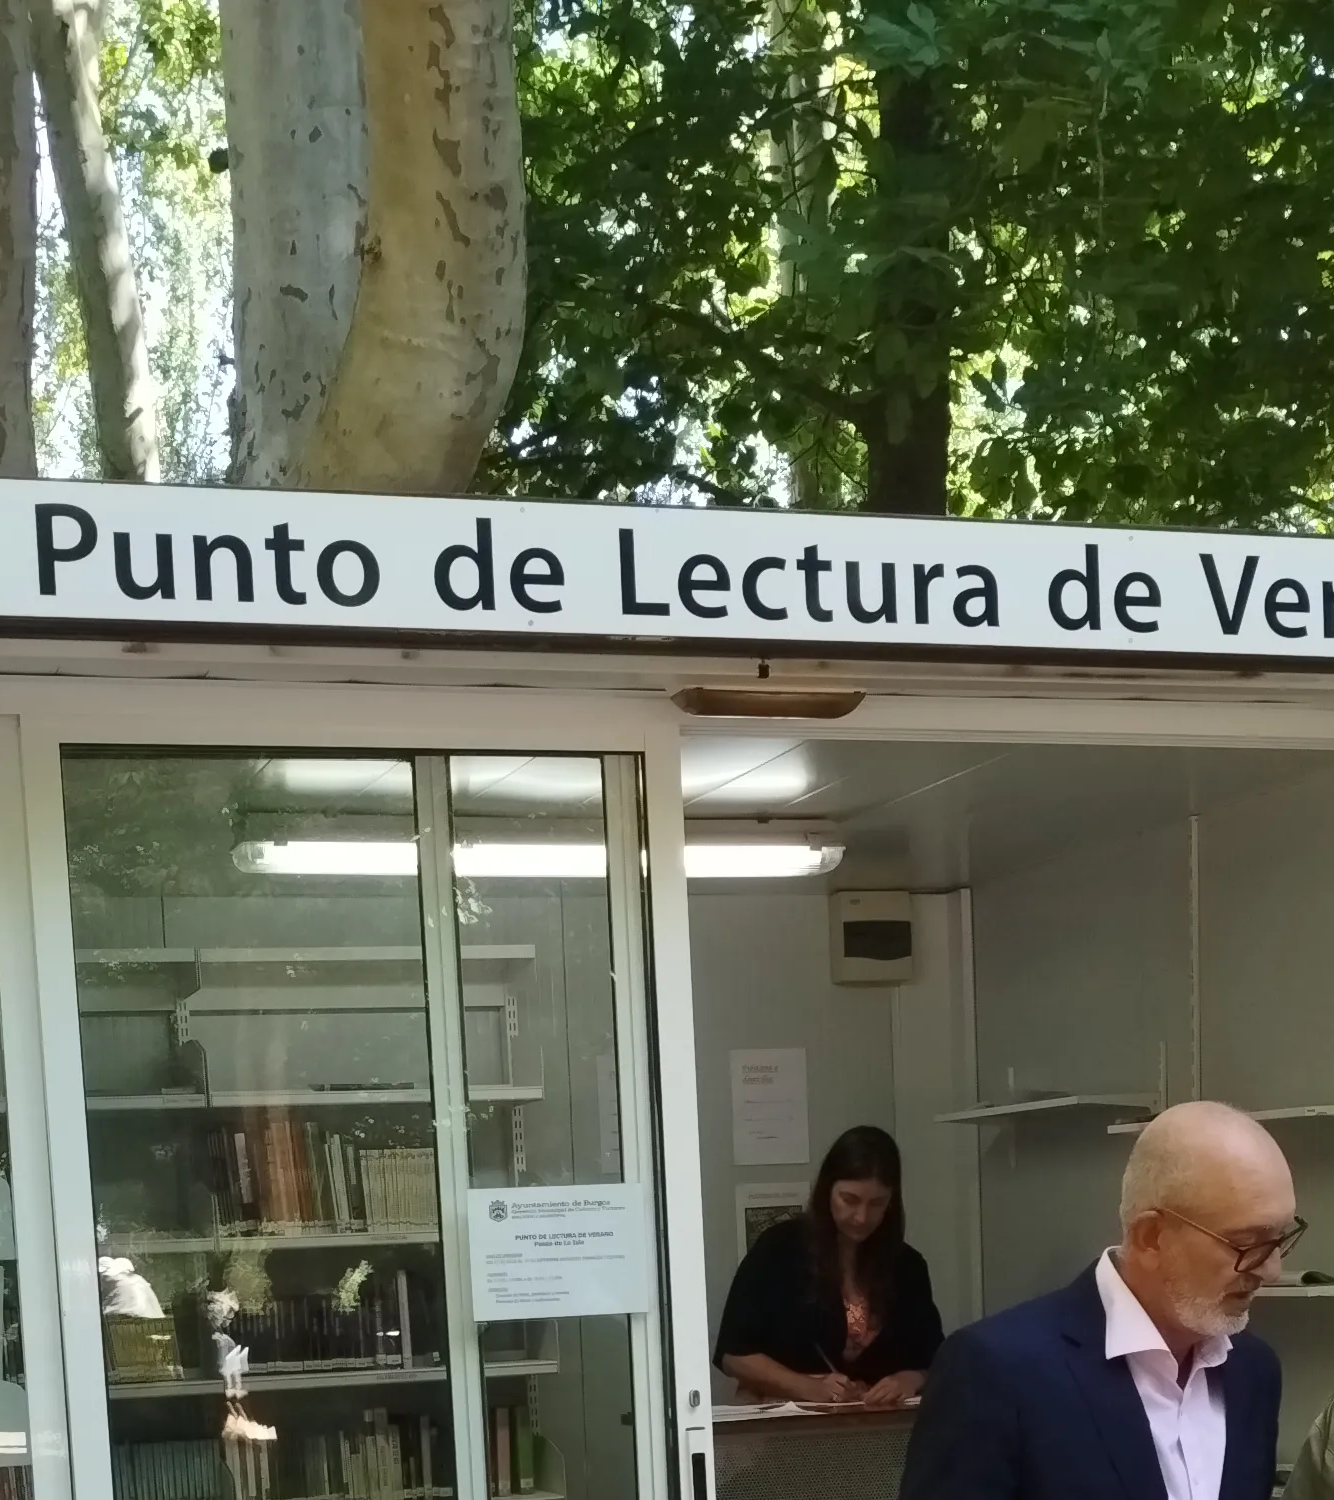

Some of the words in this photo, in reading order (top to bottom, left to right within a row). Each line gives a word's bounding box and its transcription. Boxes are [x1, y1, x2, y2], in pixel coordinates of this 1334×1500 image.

[34, 503, 381, 607] Punto
[432, 517, 565, 616] de
[617, 527, 1001, 628] Lectura
[1047, 545, 1162, 635] de
[511, 1200, 570, 1210] Ayuntamiento
[583, 1199, 611, 1208] Burgos
